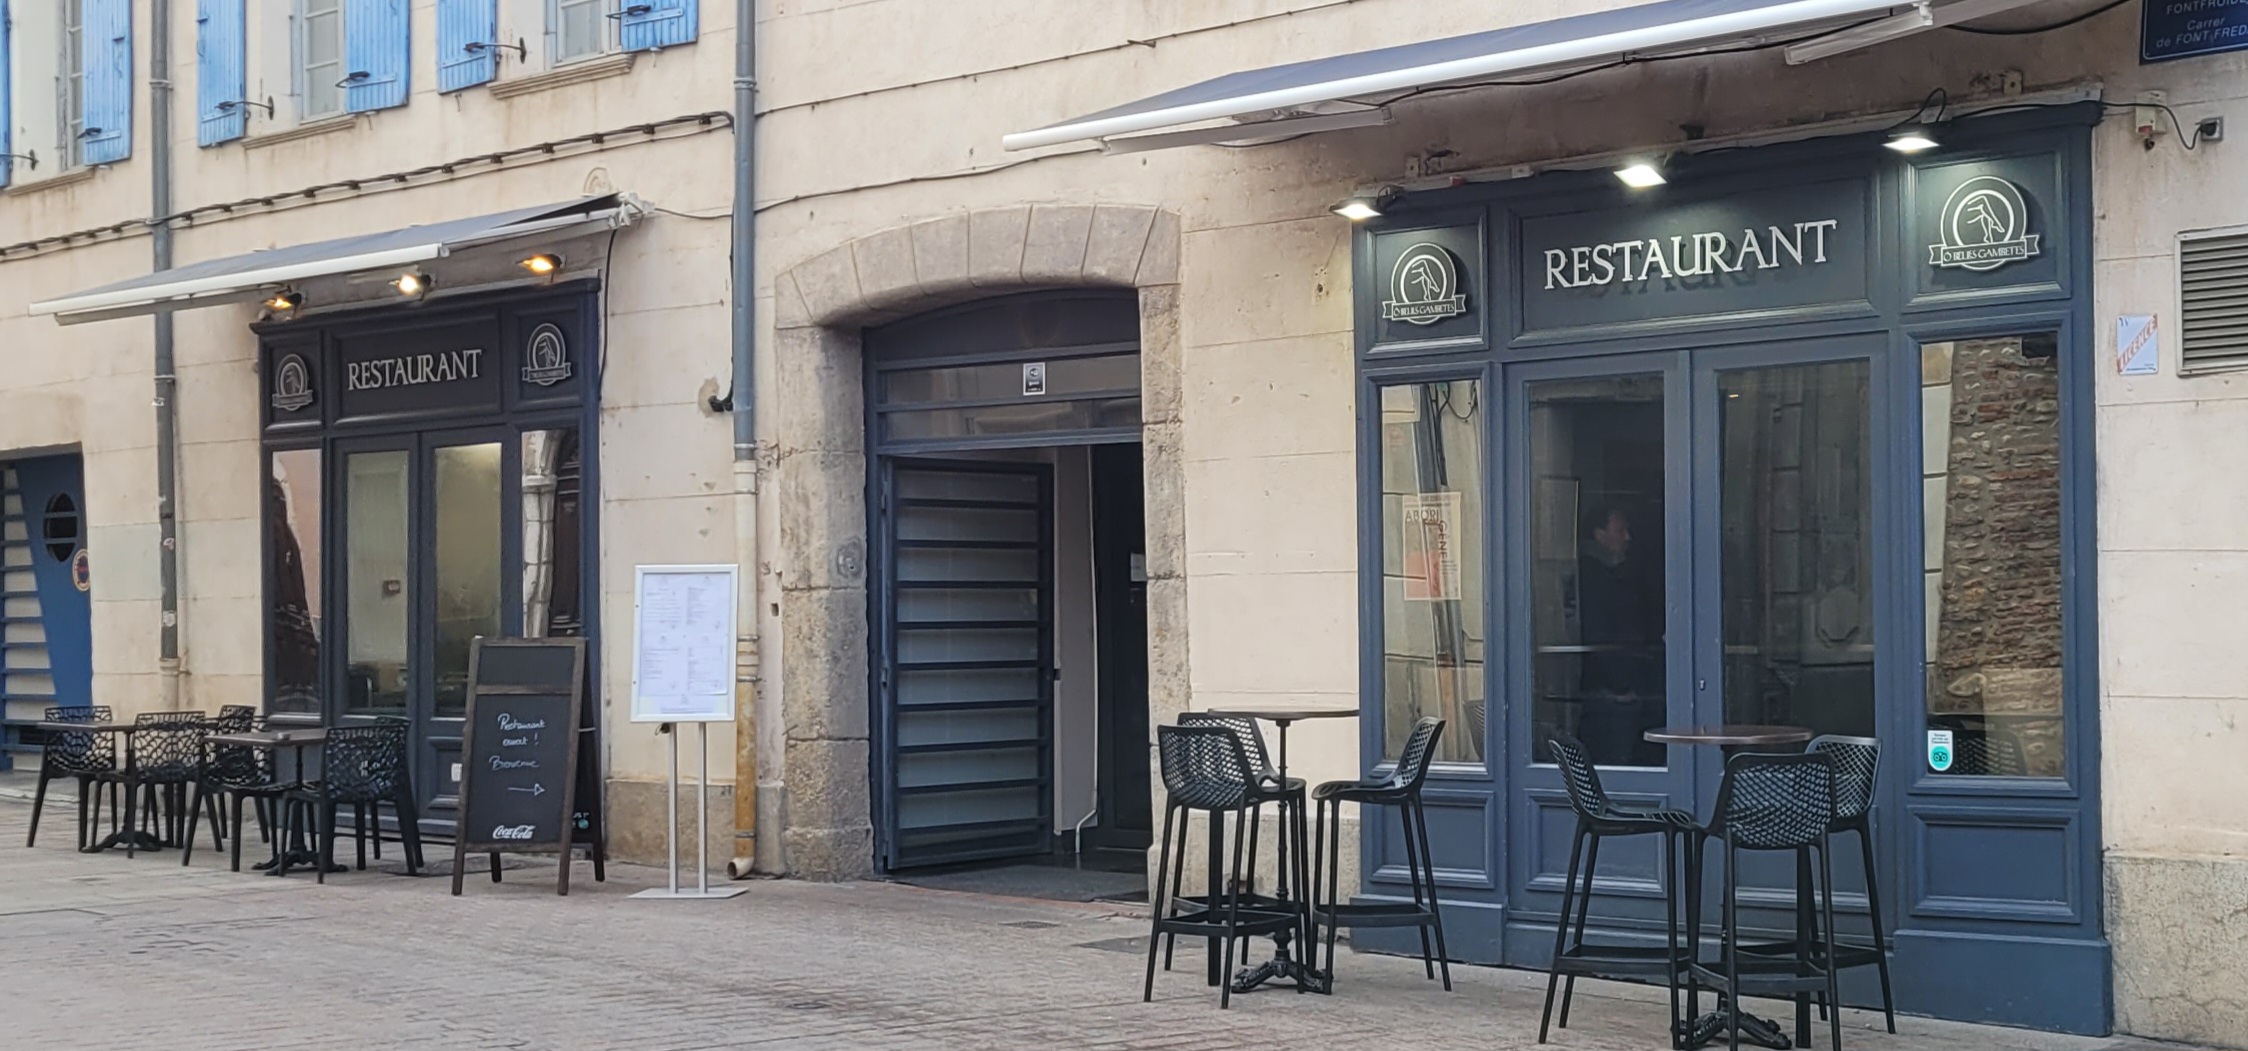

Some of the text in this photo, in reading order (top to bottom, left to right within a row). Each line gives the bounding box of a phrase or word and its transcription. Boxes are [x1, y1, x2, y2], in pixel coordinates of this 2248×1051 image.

[2166, 0, 2248, 15] FONTFROI
[2187, 17, 2226, 31] Carrer
[2156, 24, 2248, 48] de FONT FRED
[1544, 219, 1838, 290] RESTAURANT
[2117, 314, 2158, 373] LICENCE
[347, 348, 482, 391] RESTAURANT
[1405, 508, 1439, 522] ABORI
[497, 713, 546, 730] Restaurant
[492, 824, 536, 839] Coca-Cola
